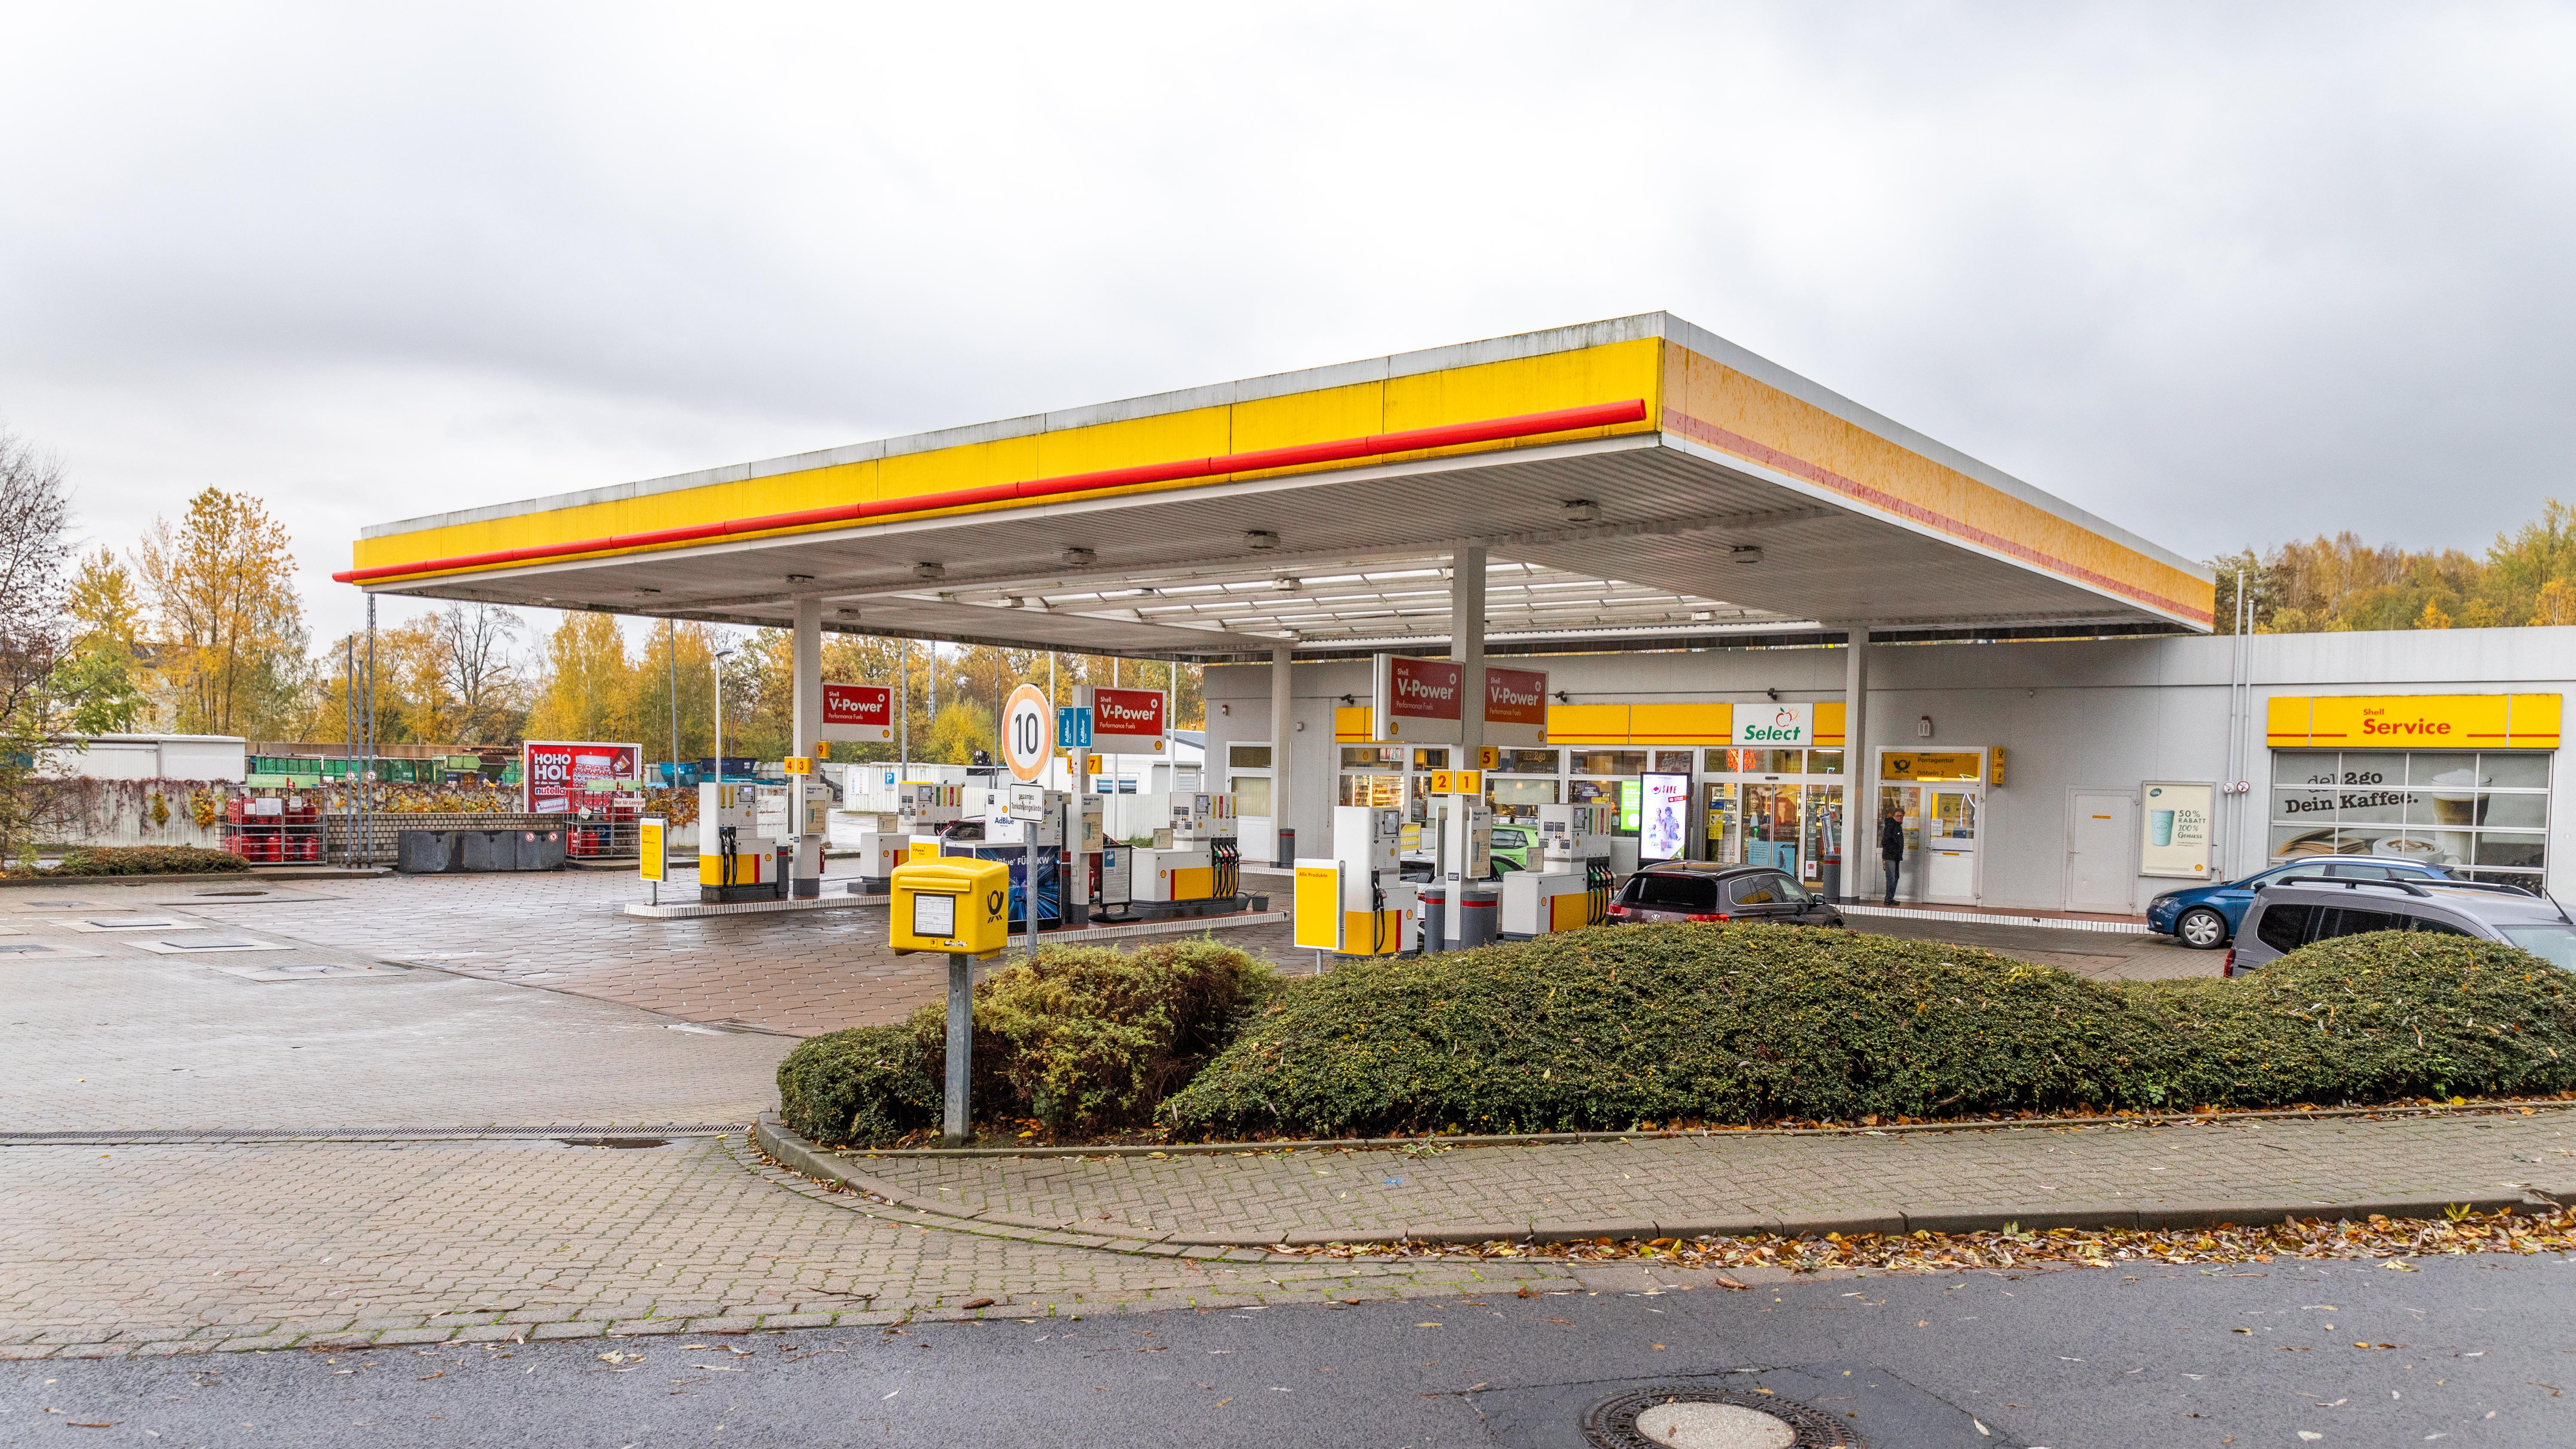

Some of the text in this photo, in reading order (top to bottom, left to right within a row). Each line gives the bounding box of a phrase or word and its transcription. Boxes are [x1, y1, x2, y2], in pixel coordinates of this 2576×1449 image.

[1397, 678, 1454, 699] V-Power
[1491, 687, 1539, 706] V-Power
[829, 698, 882, 712] V-Power
[1396, 700, 1422, 709] Performance
[1100, 704, 1155, 720] V-Power
[1489, 707, 1512, 715] Performance
[2363, 718, 2451, 734] Service
[1015, 713, 1038, 754] 10
[1744, 725, 1801, 740] Select
[819, 745, 823, 754] 9
[535, 753, 571, 764] HOHO
[1482, 751, 1490, 763] 5
[787, 761, 792, 770] 4
[799, 761, 804, 770] 3
[1090, 759, 1095, 770] 7
[535, 765, 571, 780] HOL
[887, 774, 892, 782] P
[1438, 775, 1446, 787] 2
[1464, 776, 1469, 788] 1
[535, 786, 565, 794] nutella
[1662, 785, 1677, 794] SAVE
[2285, 792, 2419, 813] Dein Kaffee.
